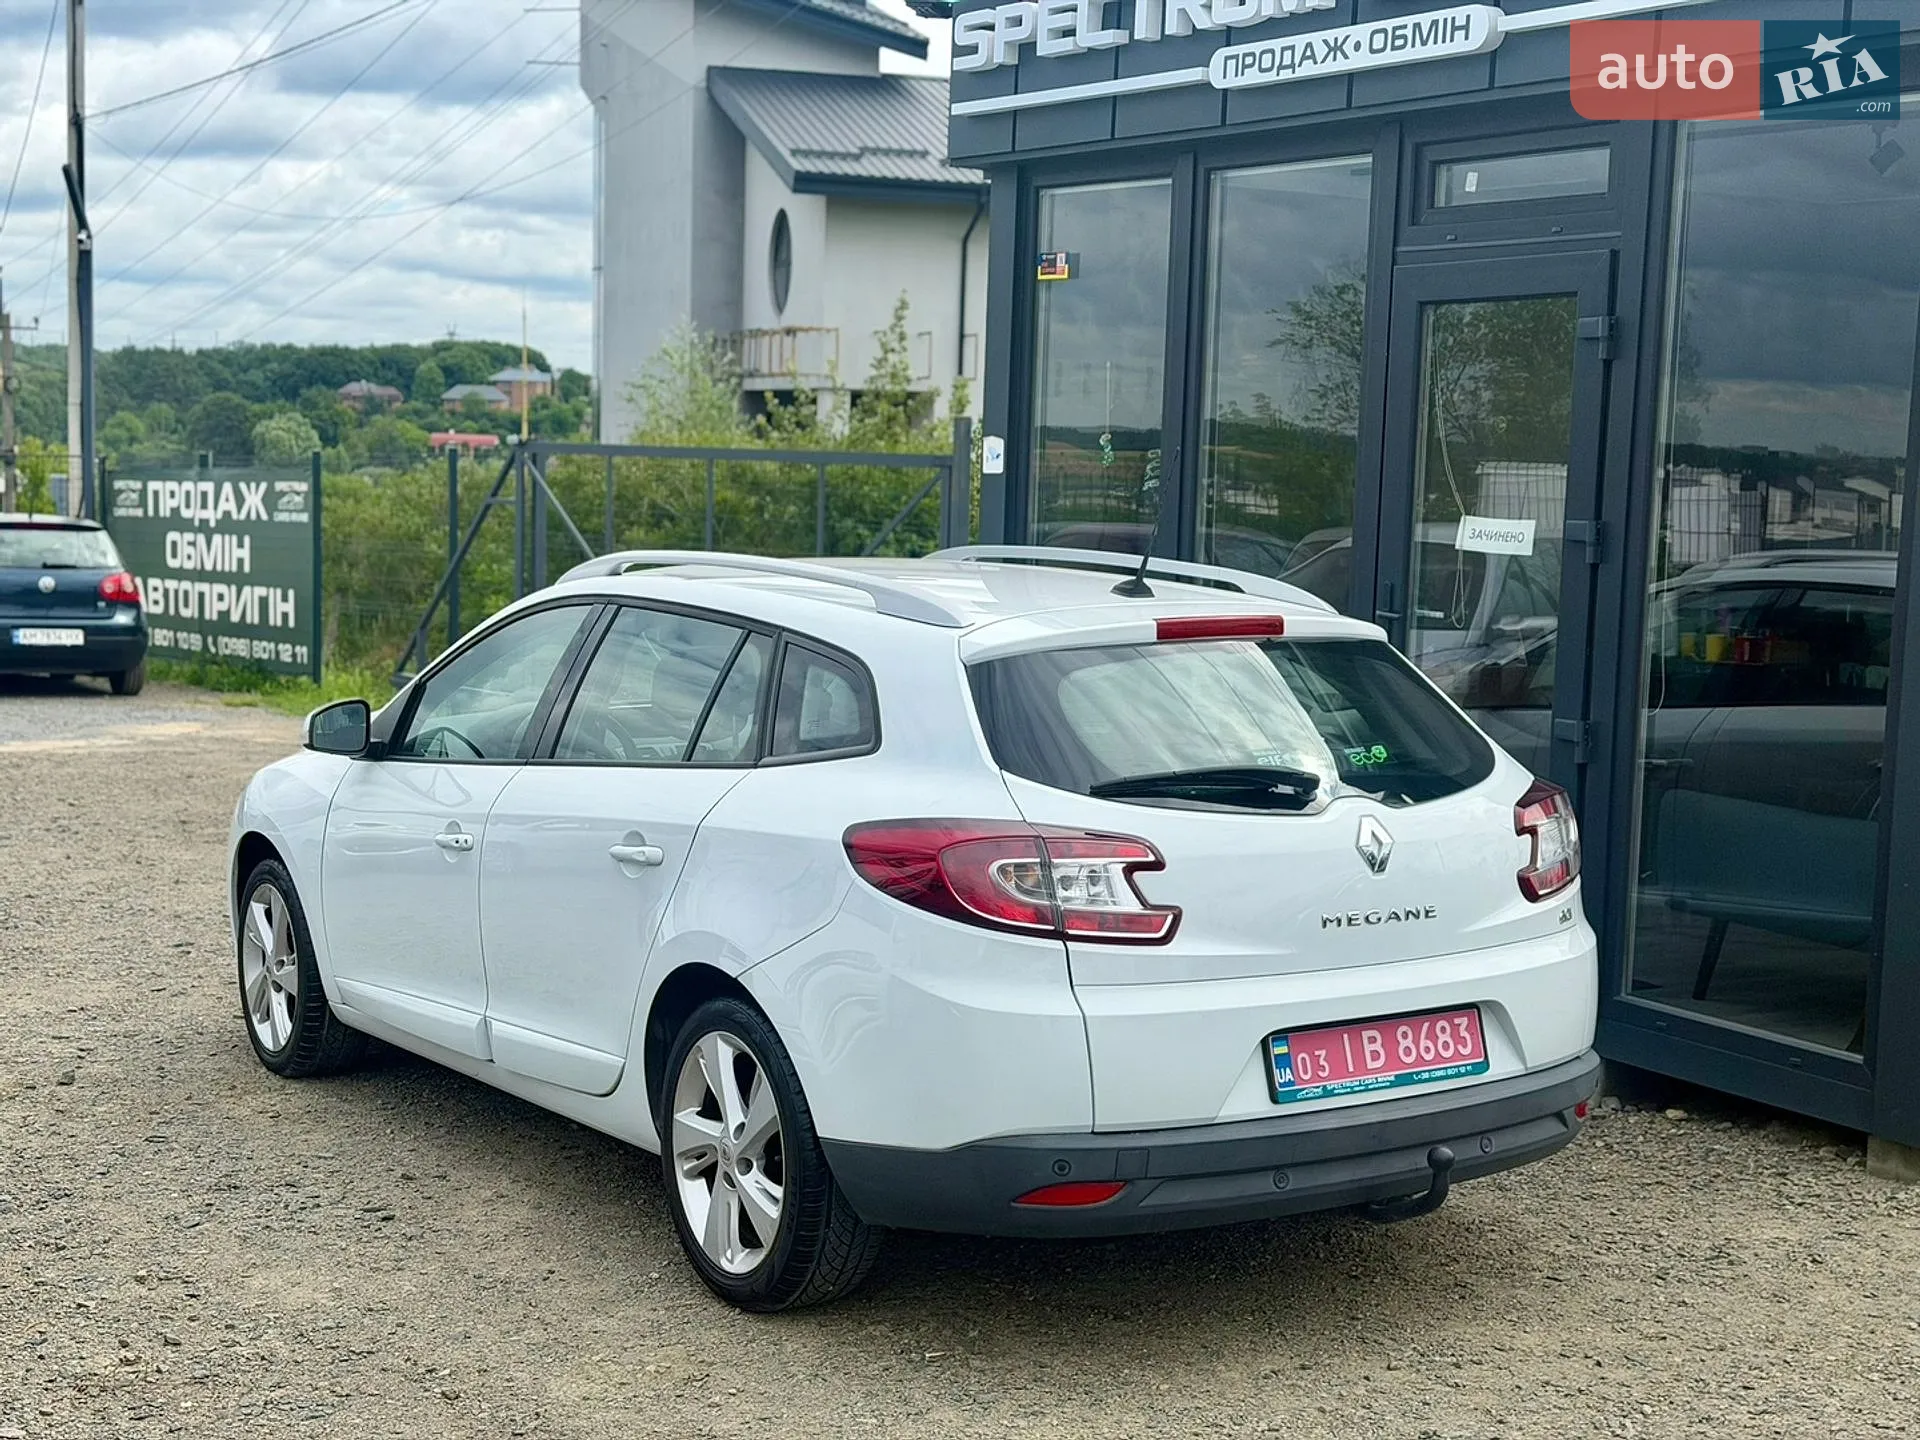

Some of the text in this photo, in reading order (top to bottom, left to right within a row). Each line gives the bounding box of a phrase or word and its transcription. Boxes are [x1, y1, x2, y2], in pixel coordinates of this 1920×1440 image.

[953, 0, 1336, 72] SPECTR
[1222, 13, 1472, 80] ПРОДАЖ ОБМІН
[146, 480, 269, 529] ПРОДАЖ
[165, 530, 251, 574] ОБМІН
[1468, 527, 1526, 544] ЗАЧИНЕНО
[1320, 903, 1438, 930] MEGANE
[1297, 1049, 1331, 1081] 03
[1396, 1016, 1473, 1065] 8683
[1276, 1066, 1295, 1084] UA
